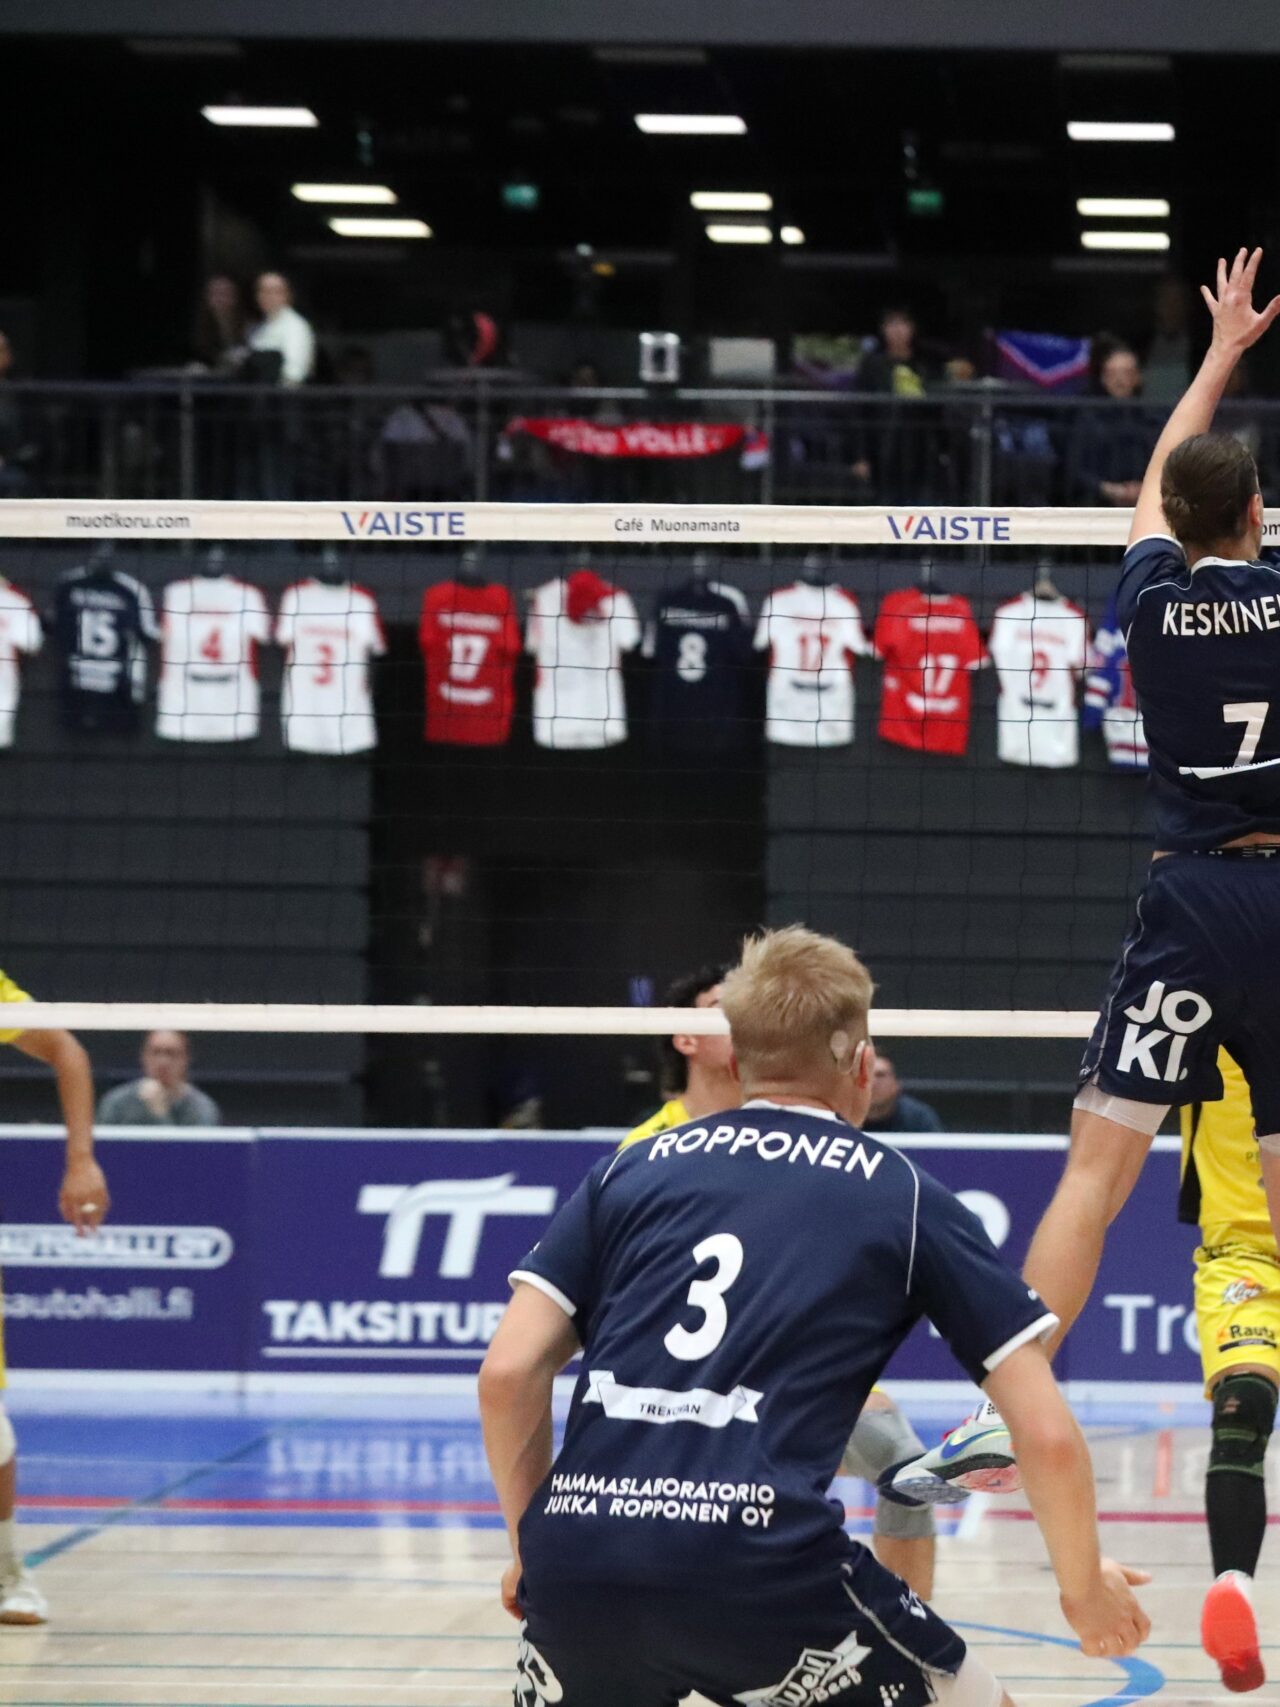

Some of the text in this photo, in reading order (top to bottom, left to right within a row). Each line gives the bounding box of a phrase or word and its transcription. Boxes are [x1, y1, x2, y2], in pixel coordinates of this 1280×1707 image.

[66, 512, 190, 530] muotikoru.com
[341, 511, 466, 536] VAISTE
[614, 517, 740, 534] Café Muonamanta
[886, 515, 1011, 542] VAISTE
[677, 632, 707, 683] 8
[918, 653, 959, 695] 17
[1223, 702, 1270, 767] 7
[1123, 980, 1213, 1034] JO
[647, 1125, 884, 1180] ROPPONEN
[663, 1232, 744, 1361] 3
[551, 1473, 776, 1505] HAMMASLABORATORIO
[543, 1493, 774, 1528] JUKKA ROPPONEN OY
